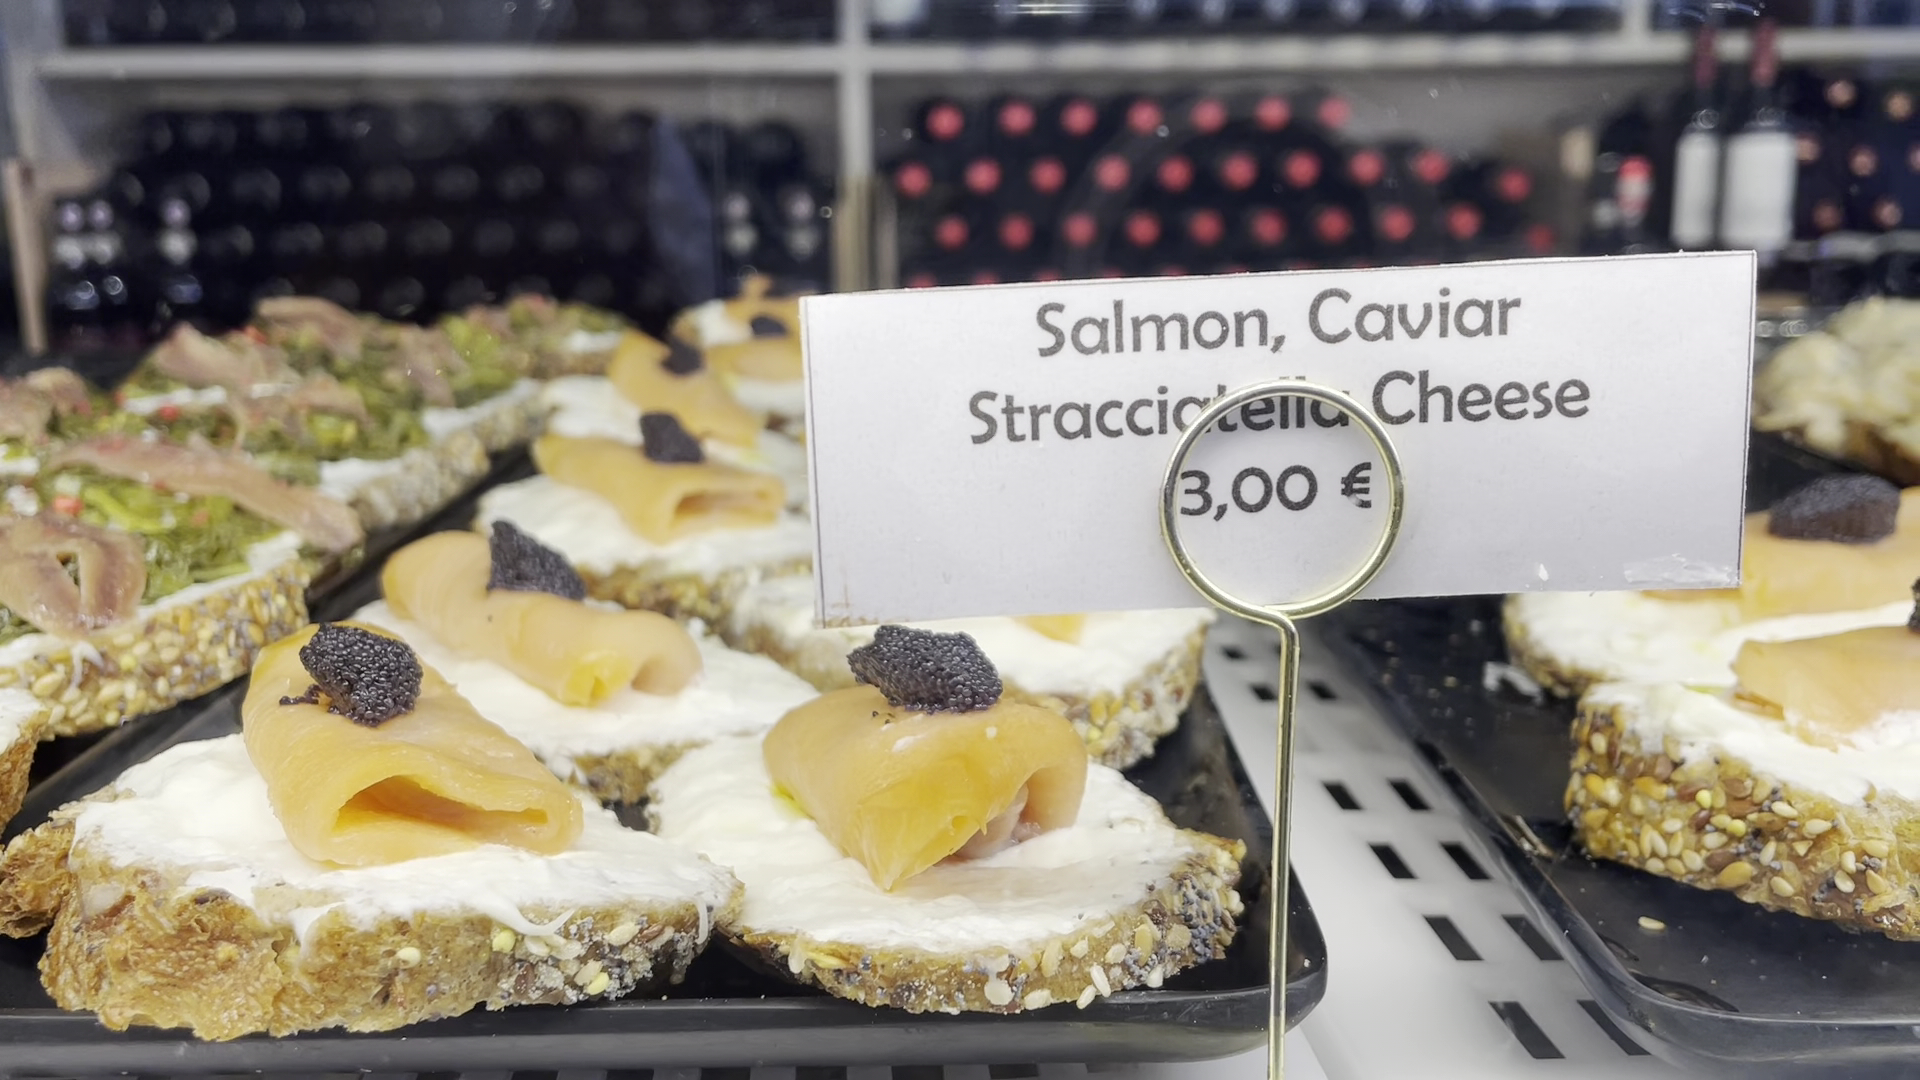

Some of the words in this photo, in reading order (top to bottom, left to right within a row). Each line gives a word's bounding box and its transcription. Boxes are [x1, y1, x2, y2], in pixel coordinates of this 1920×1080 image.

[1036, 300, 1284, 355] Salmon,
[1309, 287, 1521, 343] Caviar
[969, 376, 1350, 445] Stracciatella
[1373, 370, 1590, 426] Cheese
[1180, 465, 1319, 522] 3,00
[1340, 461, 1372, 509] €
